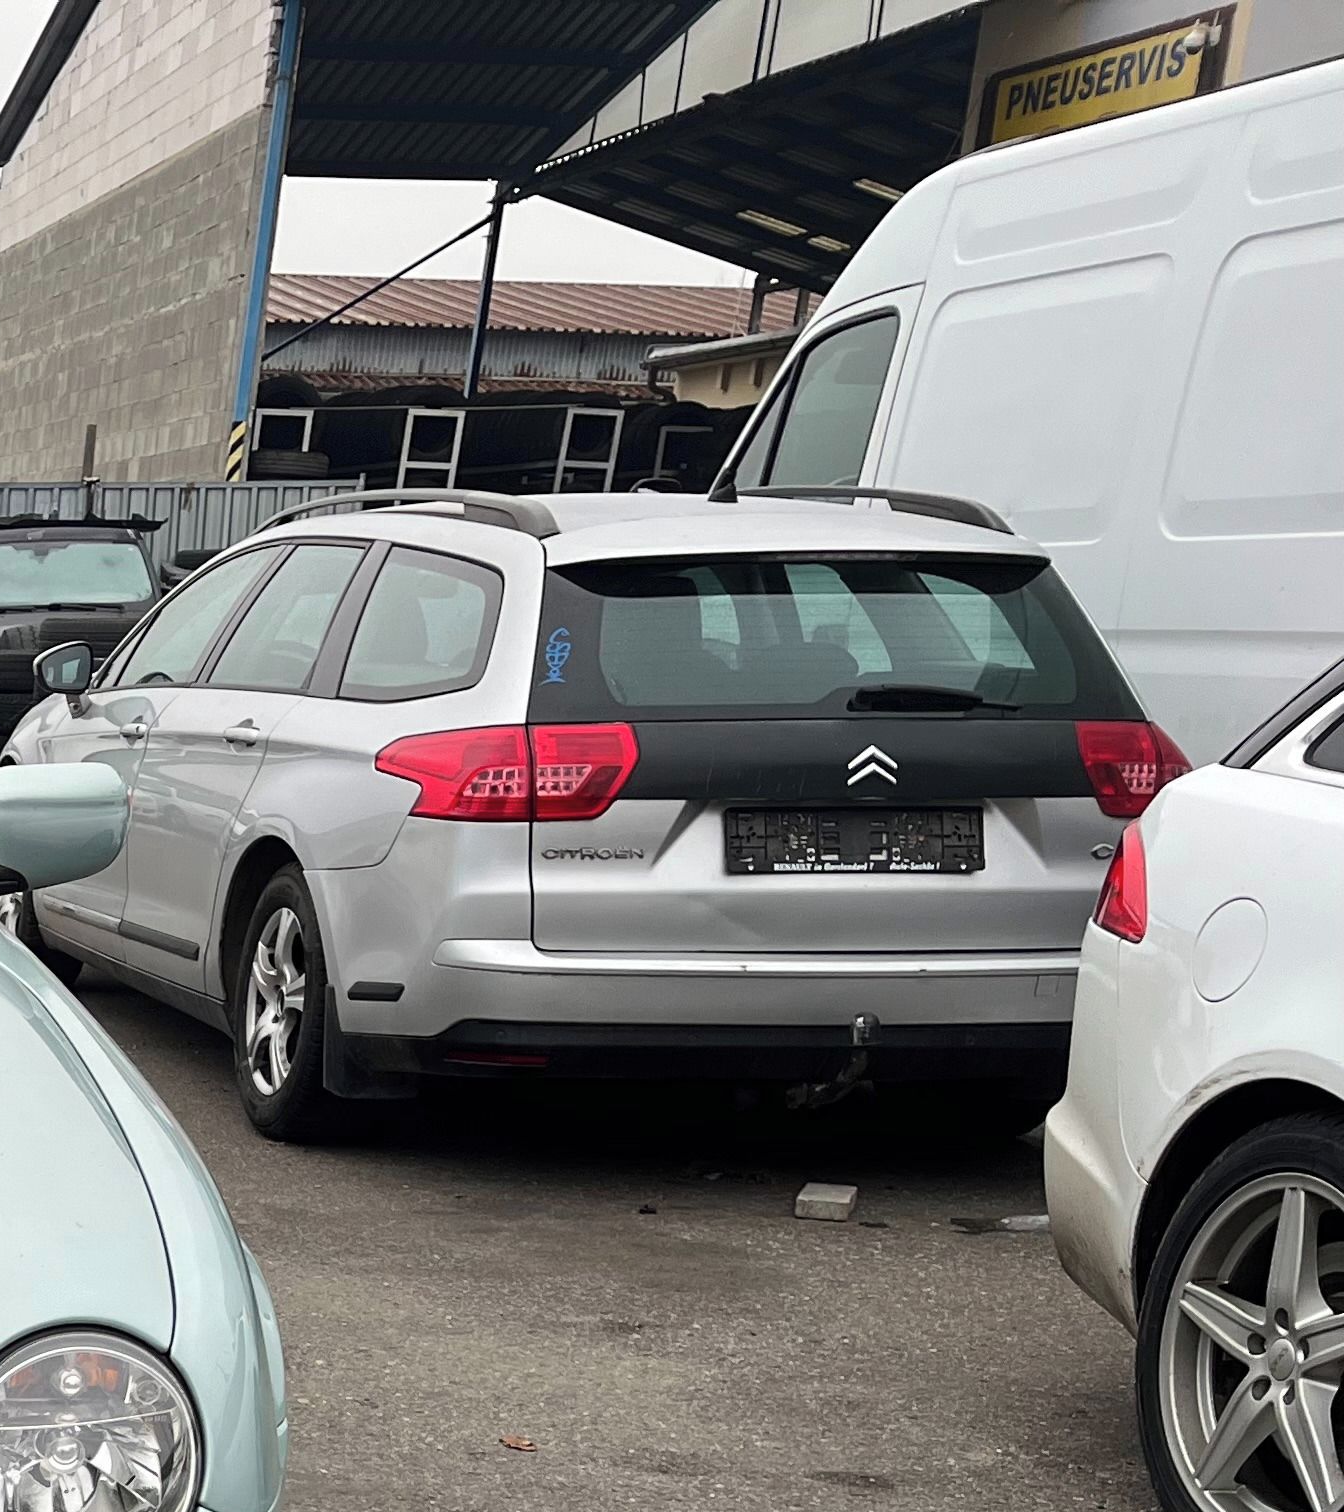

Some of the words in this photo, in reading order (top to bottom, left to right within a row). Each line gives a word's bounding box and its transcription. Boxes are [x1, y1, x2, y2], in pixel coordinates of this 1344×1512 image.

[1005, 38, 1188, 121] PNEUSERVIS
[541, 845, 644, 860] CITROËN
[773, 863, 812, 871] RENAULT
